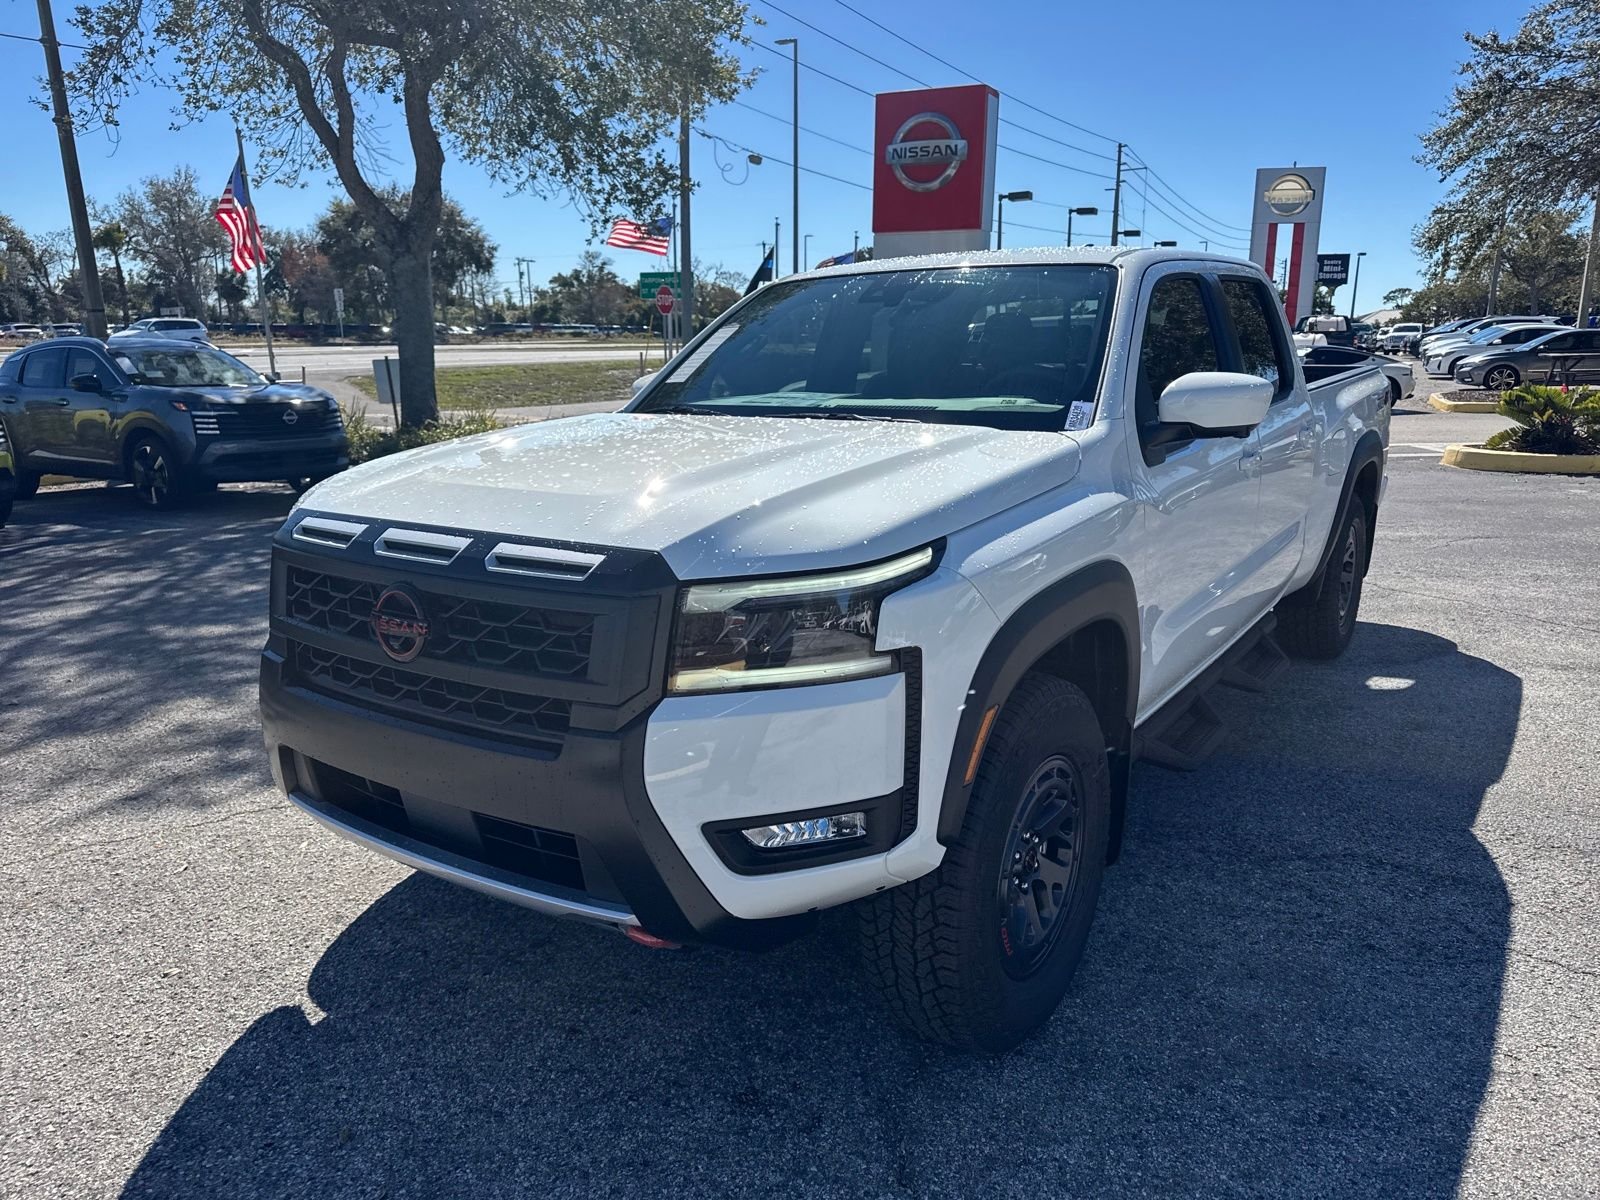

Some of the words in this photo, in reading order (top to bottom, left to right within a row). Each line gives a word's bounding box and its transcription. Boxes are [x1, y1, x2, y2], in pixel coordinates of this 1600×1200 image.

[892, 144, 959, 161] NISSAN
[1318, 272, 1347, 280] Storage
[657, 294, 673, 306] STOP
